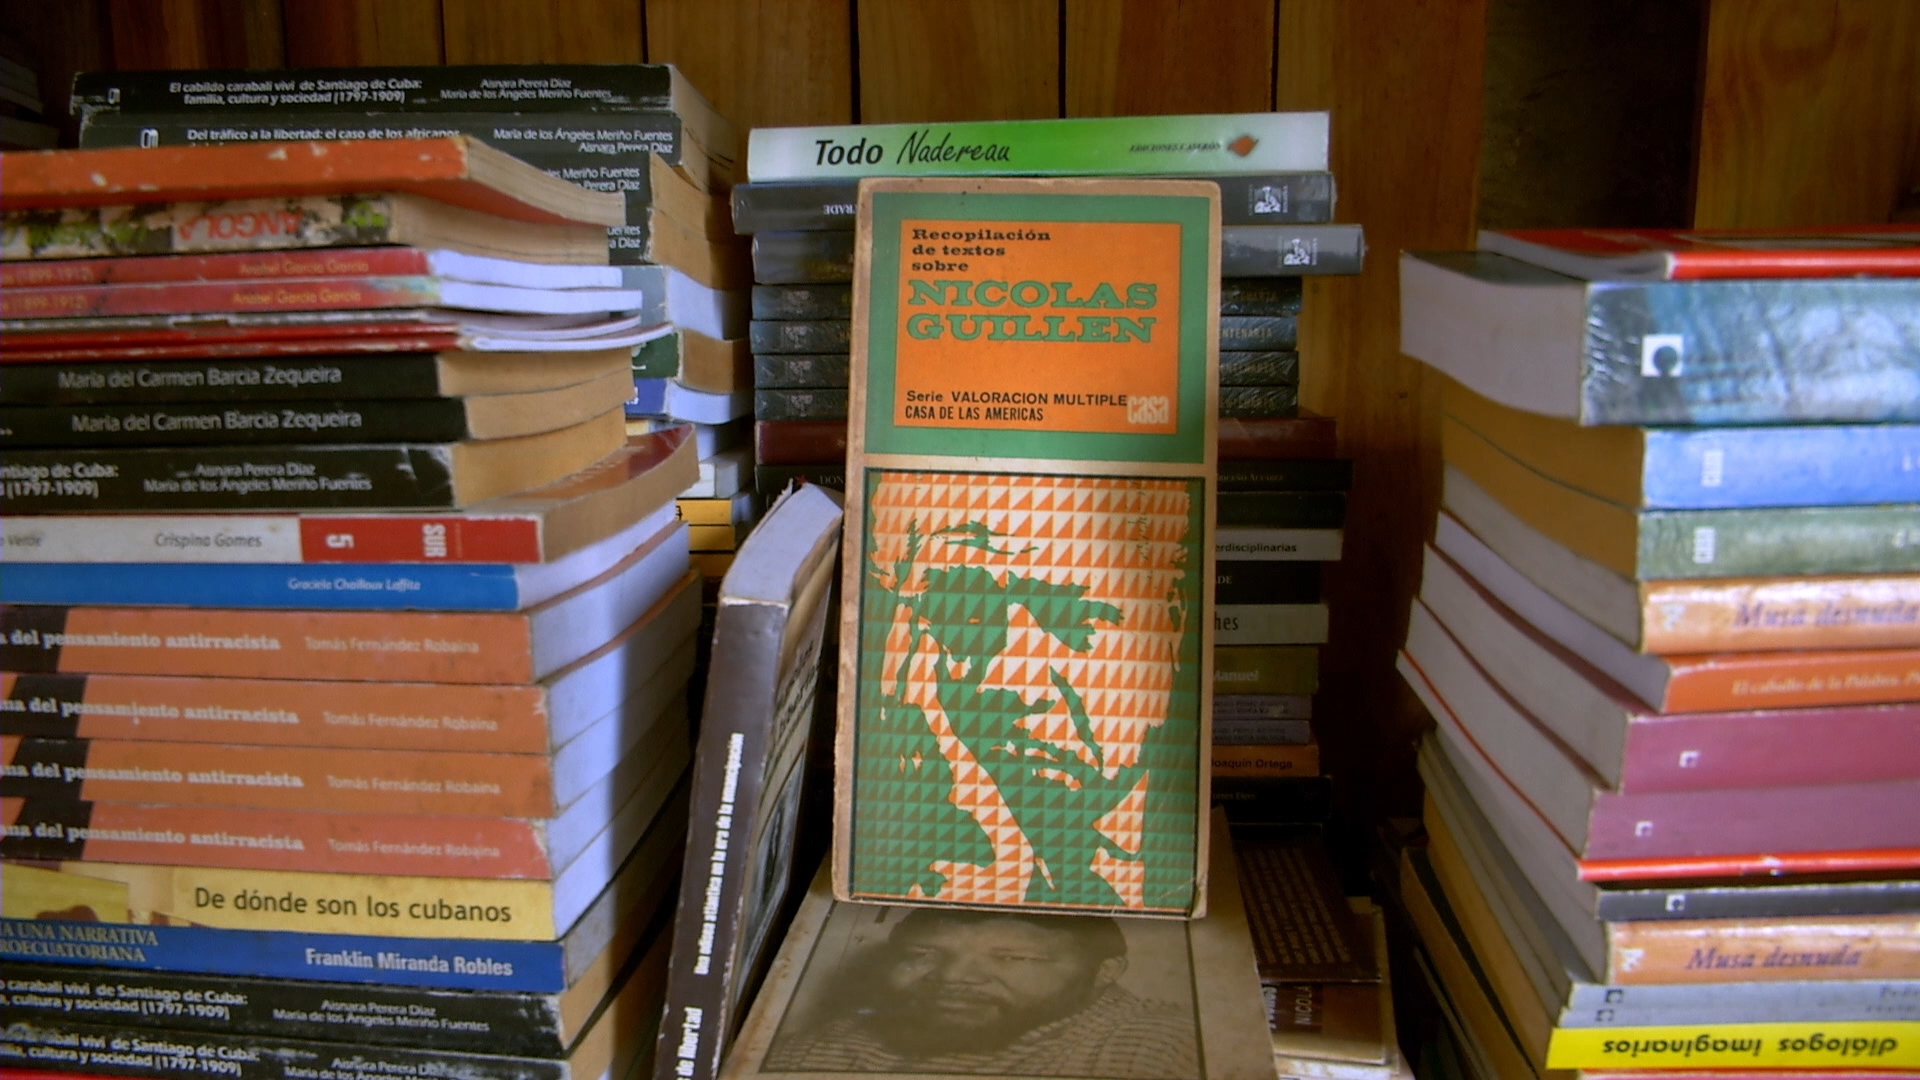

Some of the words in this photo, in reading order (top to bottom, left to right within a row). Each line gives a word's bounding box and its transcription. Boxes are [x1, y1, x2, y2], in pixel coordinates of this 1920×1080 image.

[169, 82, 181, 93] El
[183, 82, 225, 93] cabildo
[299, 80, 315, 91] de
[317, 79, 368, 94] Santiago
[370, 79, 386, 90] de
[388, 78, 422, 90] Cuba:
[469, 90, 481, 99] de
[482, 89, 497, 99] los
[574, 88, 612, 98] Fuentes
[518, 79, 548, 89] Perera
[227, 93, 268, 104] cultura
[281, 92, 332, 103] sociedad
[187, 129, 207, 140] Del
[260, 129, 271, 140] la
[273, 128, 323, 140] libertad:
[325, 128, 336, 139] el
[338, 131, 365, 139] caso
[367, 128, 383, 139] de
[385, 128, 402, 138] los
[524, 129, 537, 139] de
[539, 129, 553, 140] los
[633, 130, 673, 141] Fuentes
[815, 138, 883, 165] Todo
[897, 129, 1010, 165] Nadereau
[600, 167, 640, 178] Fuentes
[823, 204, 856, 215] RADE
[178, 210, 303, 241] ANGOLA
[911, 228, 1051, 242] Recopilación
[912, 246, 936, 256] de
[942, 246, 1006, 256] textos
[912, 260, 969, 272] sobre
[907, 279, 1158, 310] NICOLAS
[906, 313, 1157, 343] GUILLEN
[107, 370, 135, 387] del
[136, 368, 204, 388] Carmen
[207, 367, 261, 386] Barcia
[263, 365, 342, 388] Zequeira
[906, 390, 944, 403] Serie
[951, 391, 1049, 405] VALORACION
[1053, 393, 1128, 406] MULTIPLE
[123, 413, 150, 431] del
[152, 412, 222, 431] Carmen
[224, 410, 279, 429] Barcia
[281, 409, 362, 432] Zequeira
[905, 404, 936, 420] CASA
[939, 406, 954, 420] DE
[958, 406, 981, 421] LAS
[985, 407, 1045, 422] AMERICAS
[51, 463, 72, 477] de
[181, 478, 199, 492] de
[199, 477, 219, 491] los
[214, 533, 262, 548] Gomes
[325, 534, 354, 549] 5
[423, 523, 447, 558] SUR
[10, 629, 40, 646] del
[43, 630, 161, 649] pensamiento
[165, 631, 280, 651] antirracista
[424, 638, 479, 653] Robaina
[29, 696, 59, 713] del
[61, 700, 180, 718] pensamiento
[184, 704, 299, 725] antirracista
[442, 715, 498, 732] Robaina
[1255, 758, 1293, 771] Ortega
[32, 760, 61, 778] del
[64, 764, 183, 782] pensamiento
[187, 768, 304, 788] antirracista
[445, 779, 501, 795] Robaina
[34, 821, 64, 839] del
[67, 825, 186, 843] pensamiento
[190, 829, 305, 850] antirracista
[445, 841, 501, 858] Robaina
[195, 887, 226, 909] De
[233, 888, 308, 914] dónde
[317, 899, 357, 917] son
[367, 895, 400, 918] los
[409, 898, 513, 923] cubanos
[17, 923, 55, 940] UNA
[59, 926, 159, 947] NARRATIVA
[0, 939, 147, 963] ROECUATORIANA
[305, 947, 374, 970] Franklin
[376, 951, 450, 974] Miranda
[453, 956, 514, 977] Robles
[1685, 947, 1755, 970] Musa
[1762, 944, 1863, 969] desnuda
[12, 993, 62, 1009] cultura
[75, 998, 139, 1014] sociedad
[96, 983, 115, 997] de
[117, 984, 182, 1004] Santiago
[183, 988, 203, 1002] de
[204, 990, 248, 1006] Cuba:
[308, 1010, 324, 1023] de
[324, 1011, 344, 1024] los
[441, 1017, 490, 1033] Fuentes
[110, 1037, 130, 1051] de
[132, 1037, 195, 1058] Santiago
[196, 1043, 216, 1058] de
[1603, 1033, 1763, 1058] imaginarios
[1778, 1032, 1898, 1058] diálogos
[28, 1046, 79, 1063] cultura
[90, 1052, 153, 1068] sociedad
